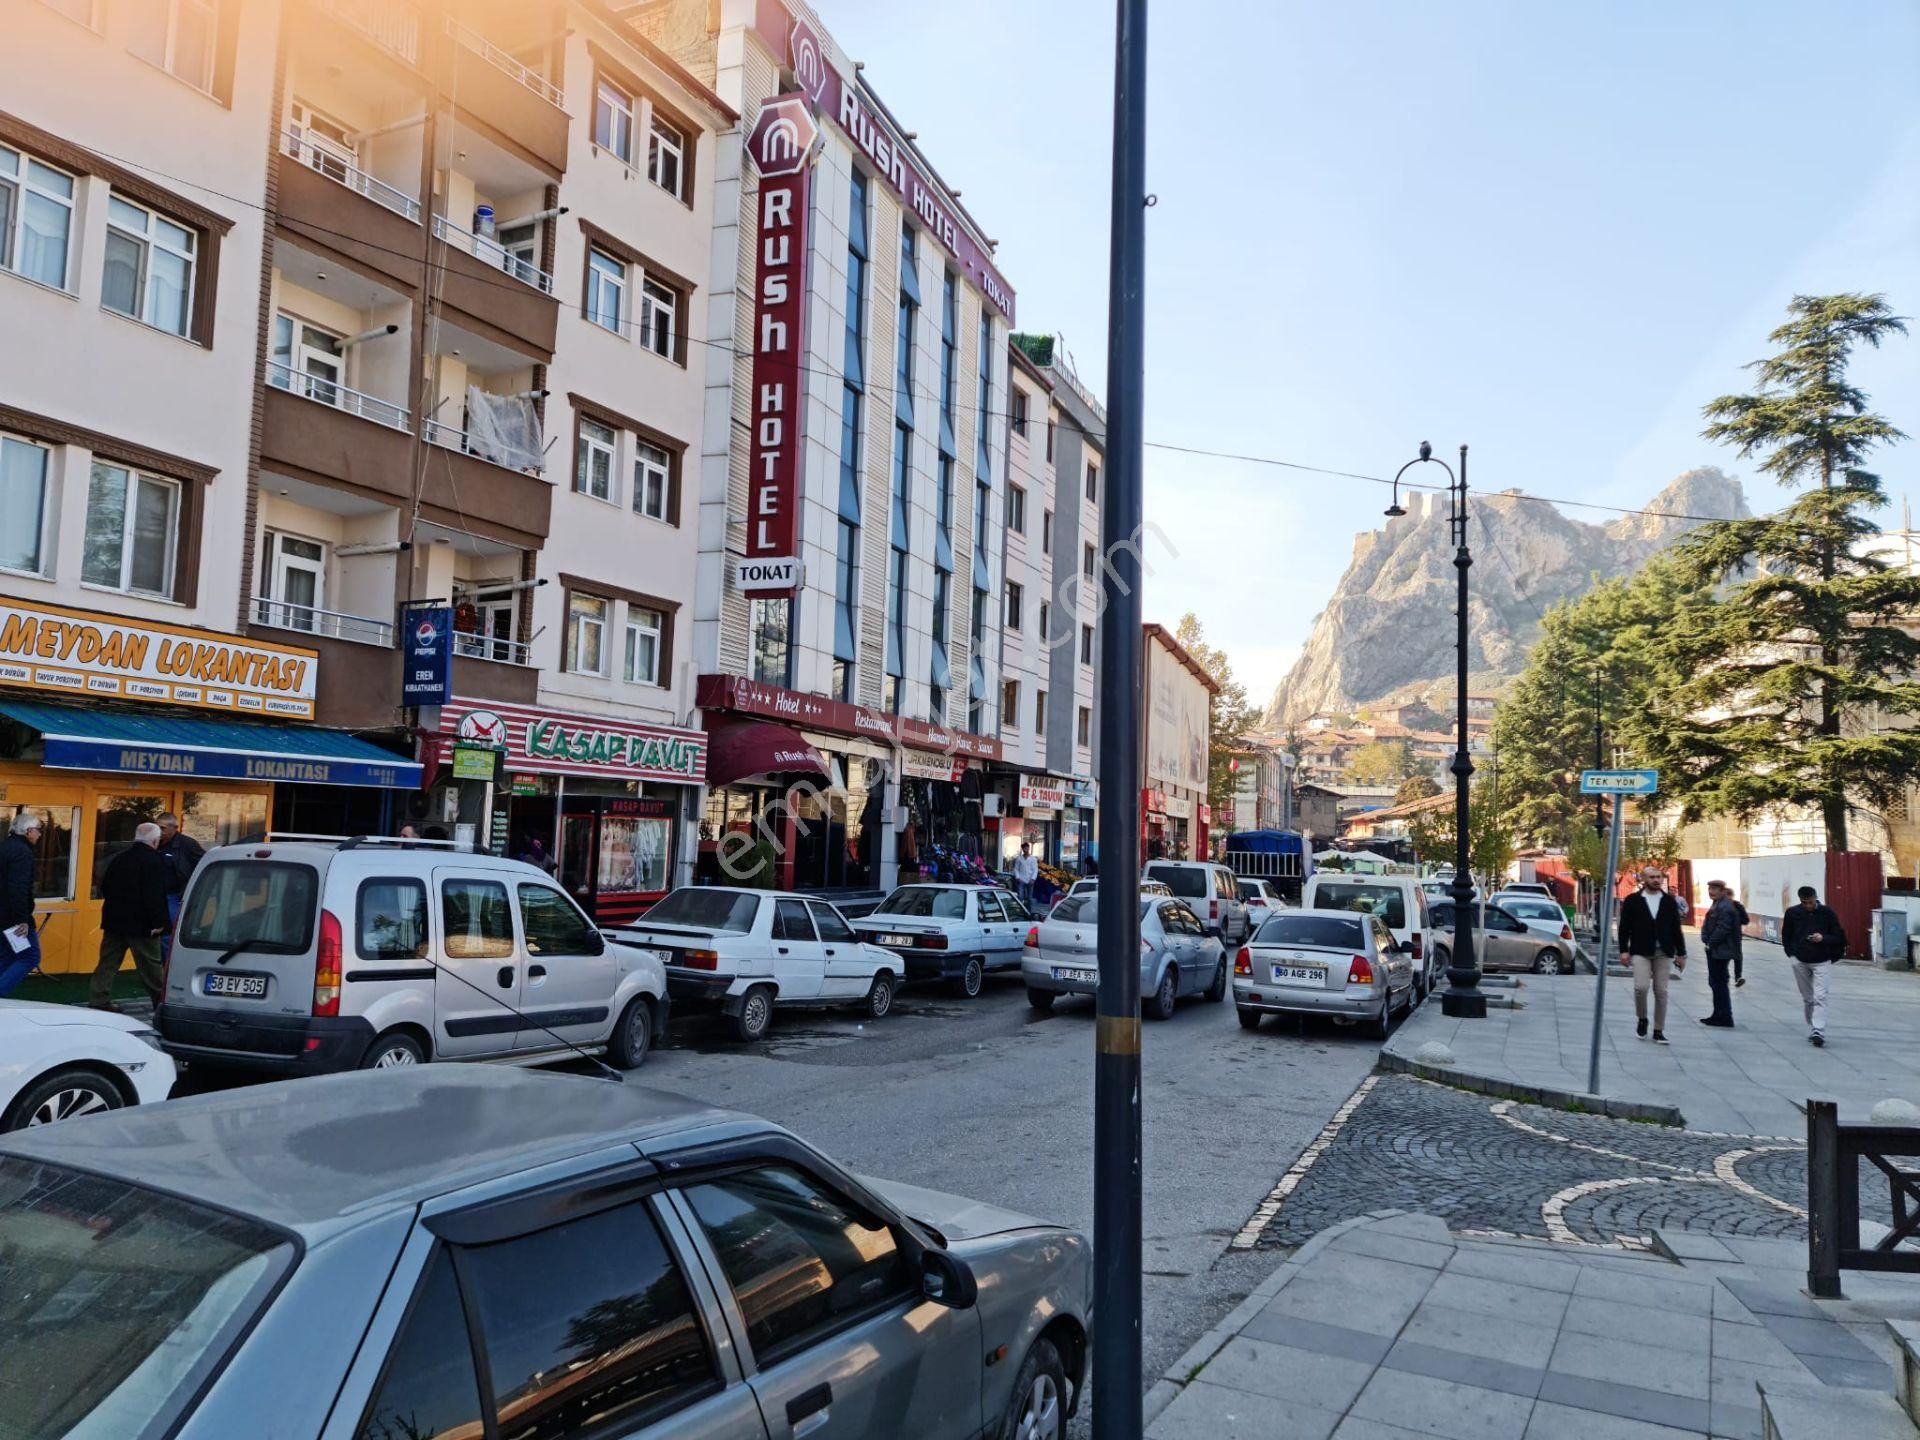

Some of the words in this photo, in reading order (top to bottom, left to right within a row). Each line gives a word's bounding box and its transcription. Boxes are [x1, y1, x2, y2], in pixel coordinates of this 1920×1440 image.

[913, 180, 960, 259] HOTEL
[982, 270, 1012, 317] TOKAT
[757, 382, 784, 551] HOTEL
[739, 564, 794, 582] TOKAT
[1, 614, 150, 671] MEYDAN
[156, 639, 307, 692] LOKANTASI
[416, 670, 434, 680] EREN
[775, 691, 800, 714] Hotel
[525, 717, 625, 765] KASAP
[624, 734, 702, 778] DAVUT
[781, 750, 806, 761] Rush
[120, 750, 195, 773] MEYDAN
[245, 759, 329, 781] LOKANTASI
[1590, 777, 1609, 785] TEK
[211, 976, 223, 990] 58
[226, 978, 241, 991] EV
[243, 979, 263, 993] 505
[1309, 970, 1323, 980] 296
